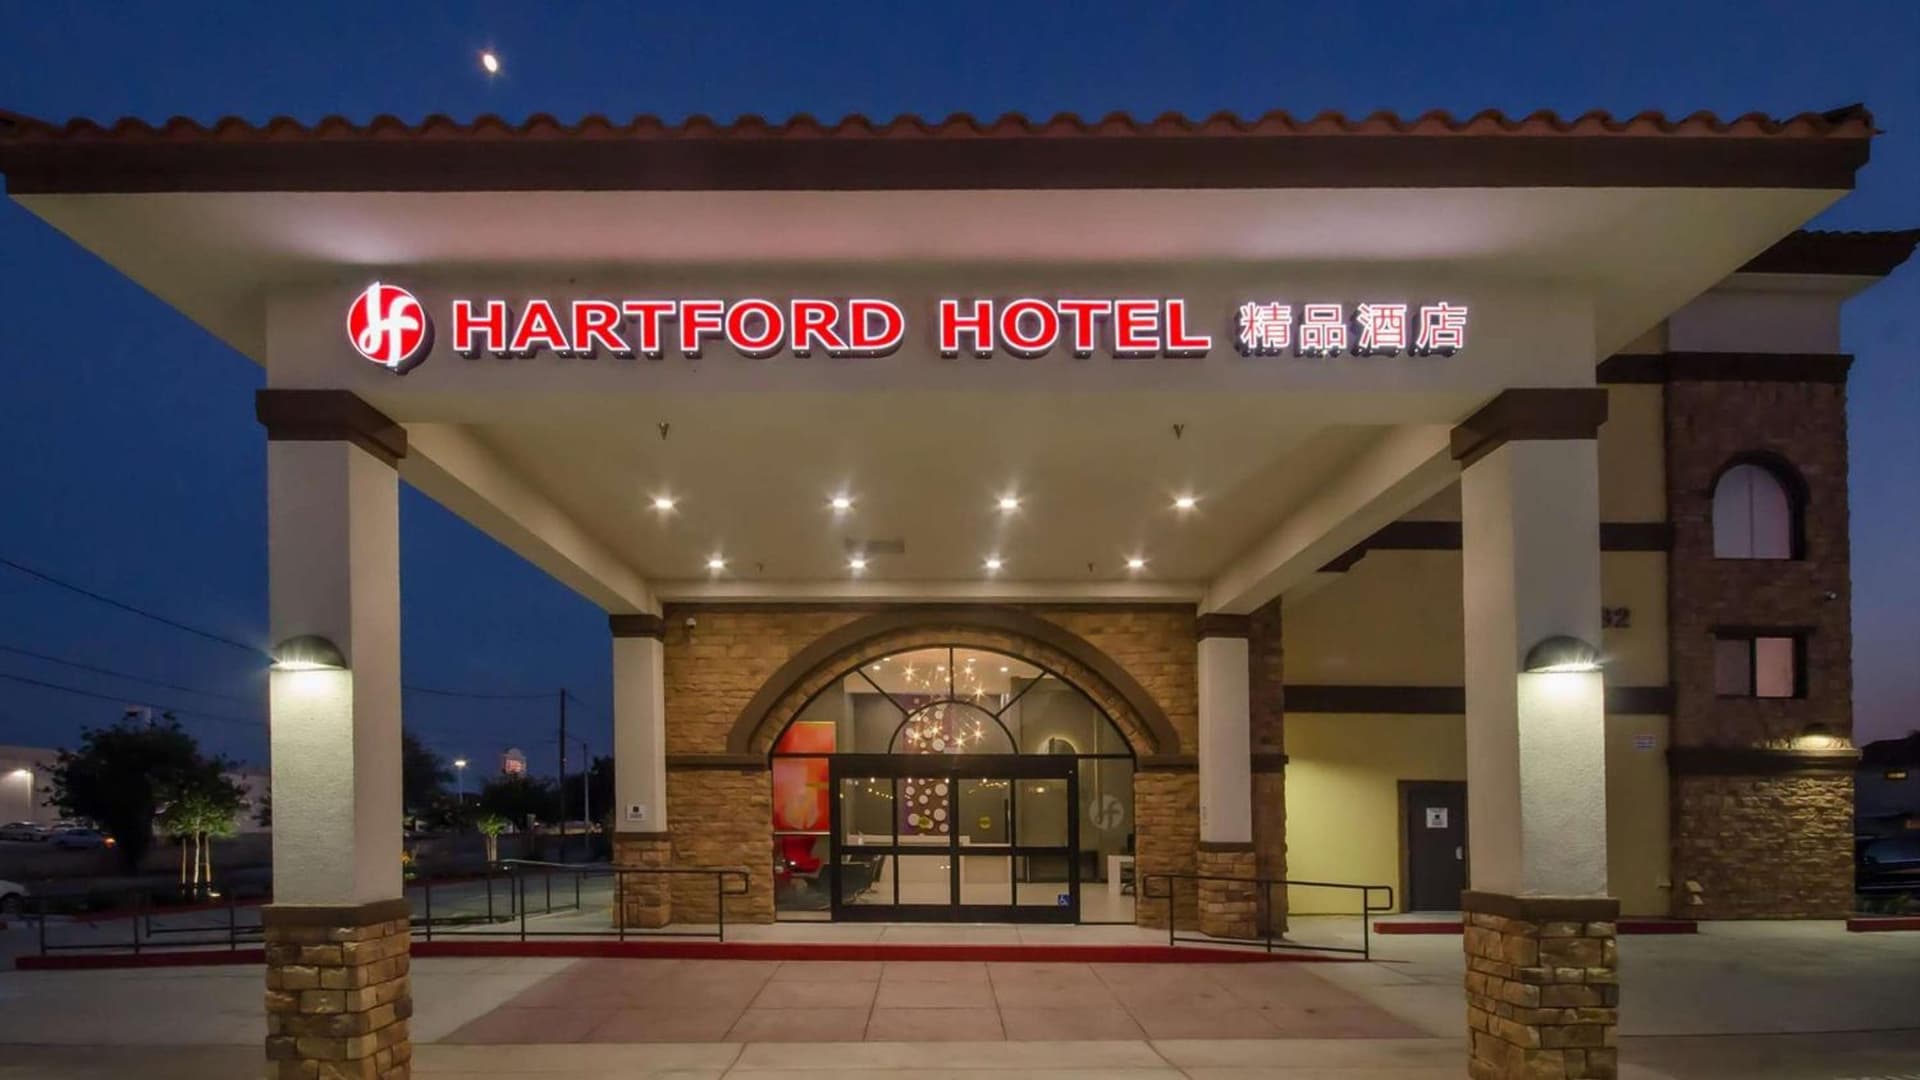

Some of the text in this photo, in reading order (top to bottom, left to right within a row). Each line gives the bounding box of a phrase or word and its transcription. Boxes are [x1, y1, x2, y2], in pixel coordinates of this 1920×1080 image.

[452, 299, 1212, 352] HARTFORD HOTEL
[1239, 301, 1468, 350] 精品酒店
